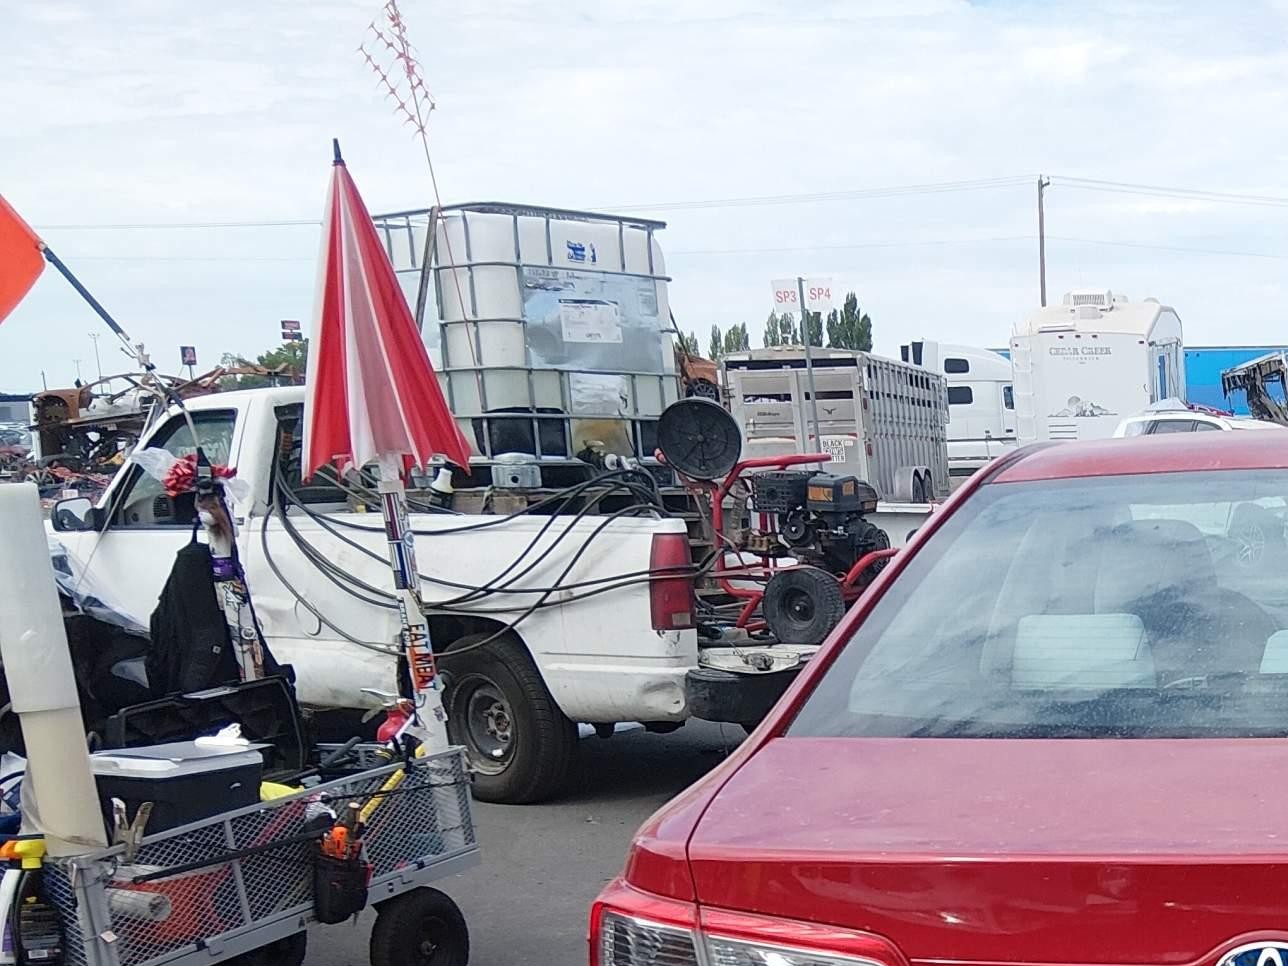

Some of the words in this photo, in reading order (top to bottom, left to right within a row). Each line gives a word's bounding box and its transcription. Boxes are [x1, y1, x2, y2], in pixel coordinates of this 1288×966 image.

[775, 290, 797, 303] SP3
[809, 287, 831, 300] SP4
[1081, 346, 1112, 356] CREEK
[822, 439, 843, 447] BLACK
[408, 624, 428, 648] EAT
[415, 653, 437, 690] MEAT
